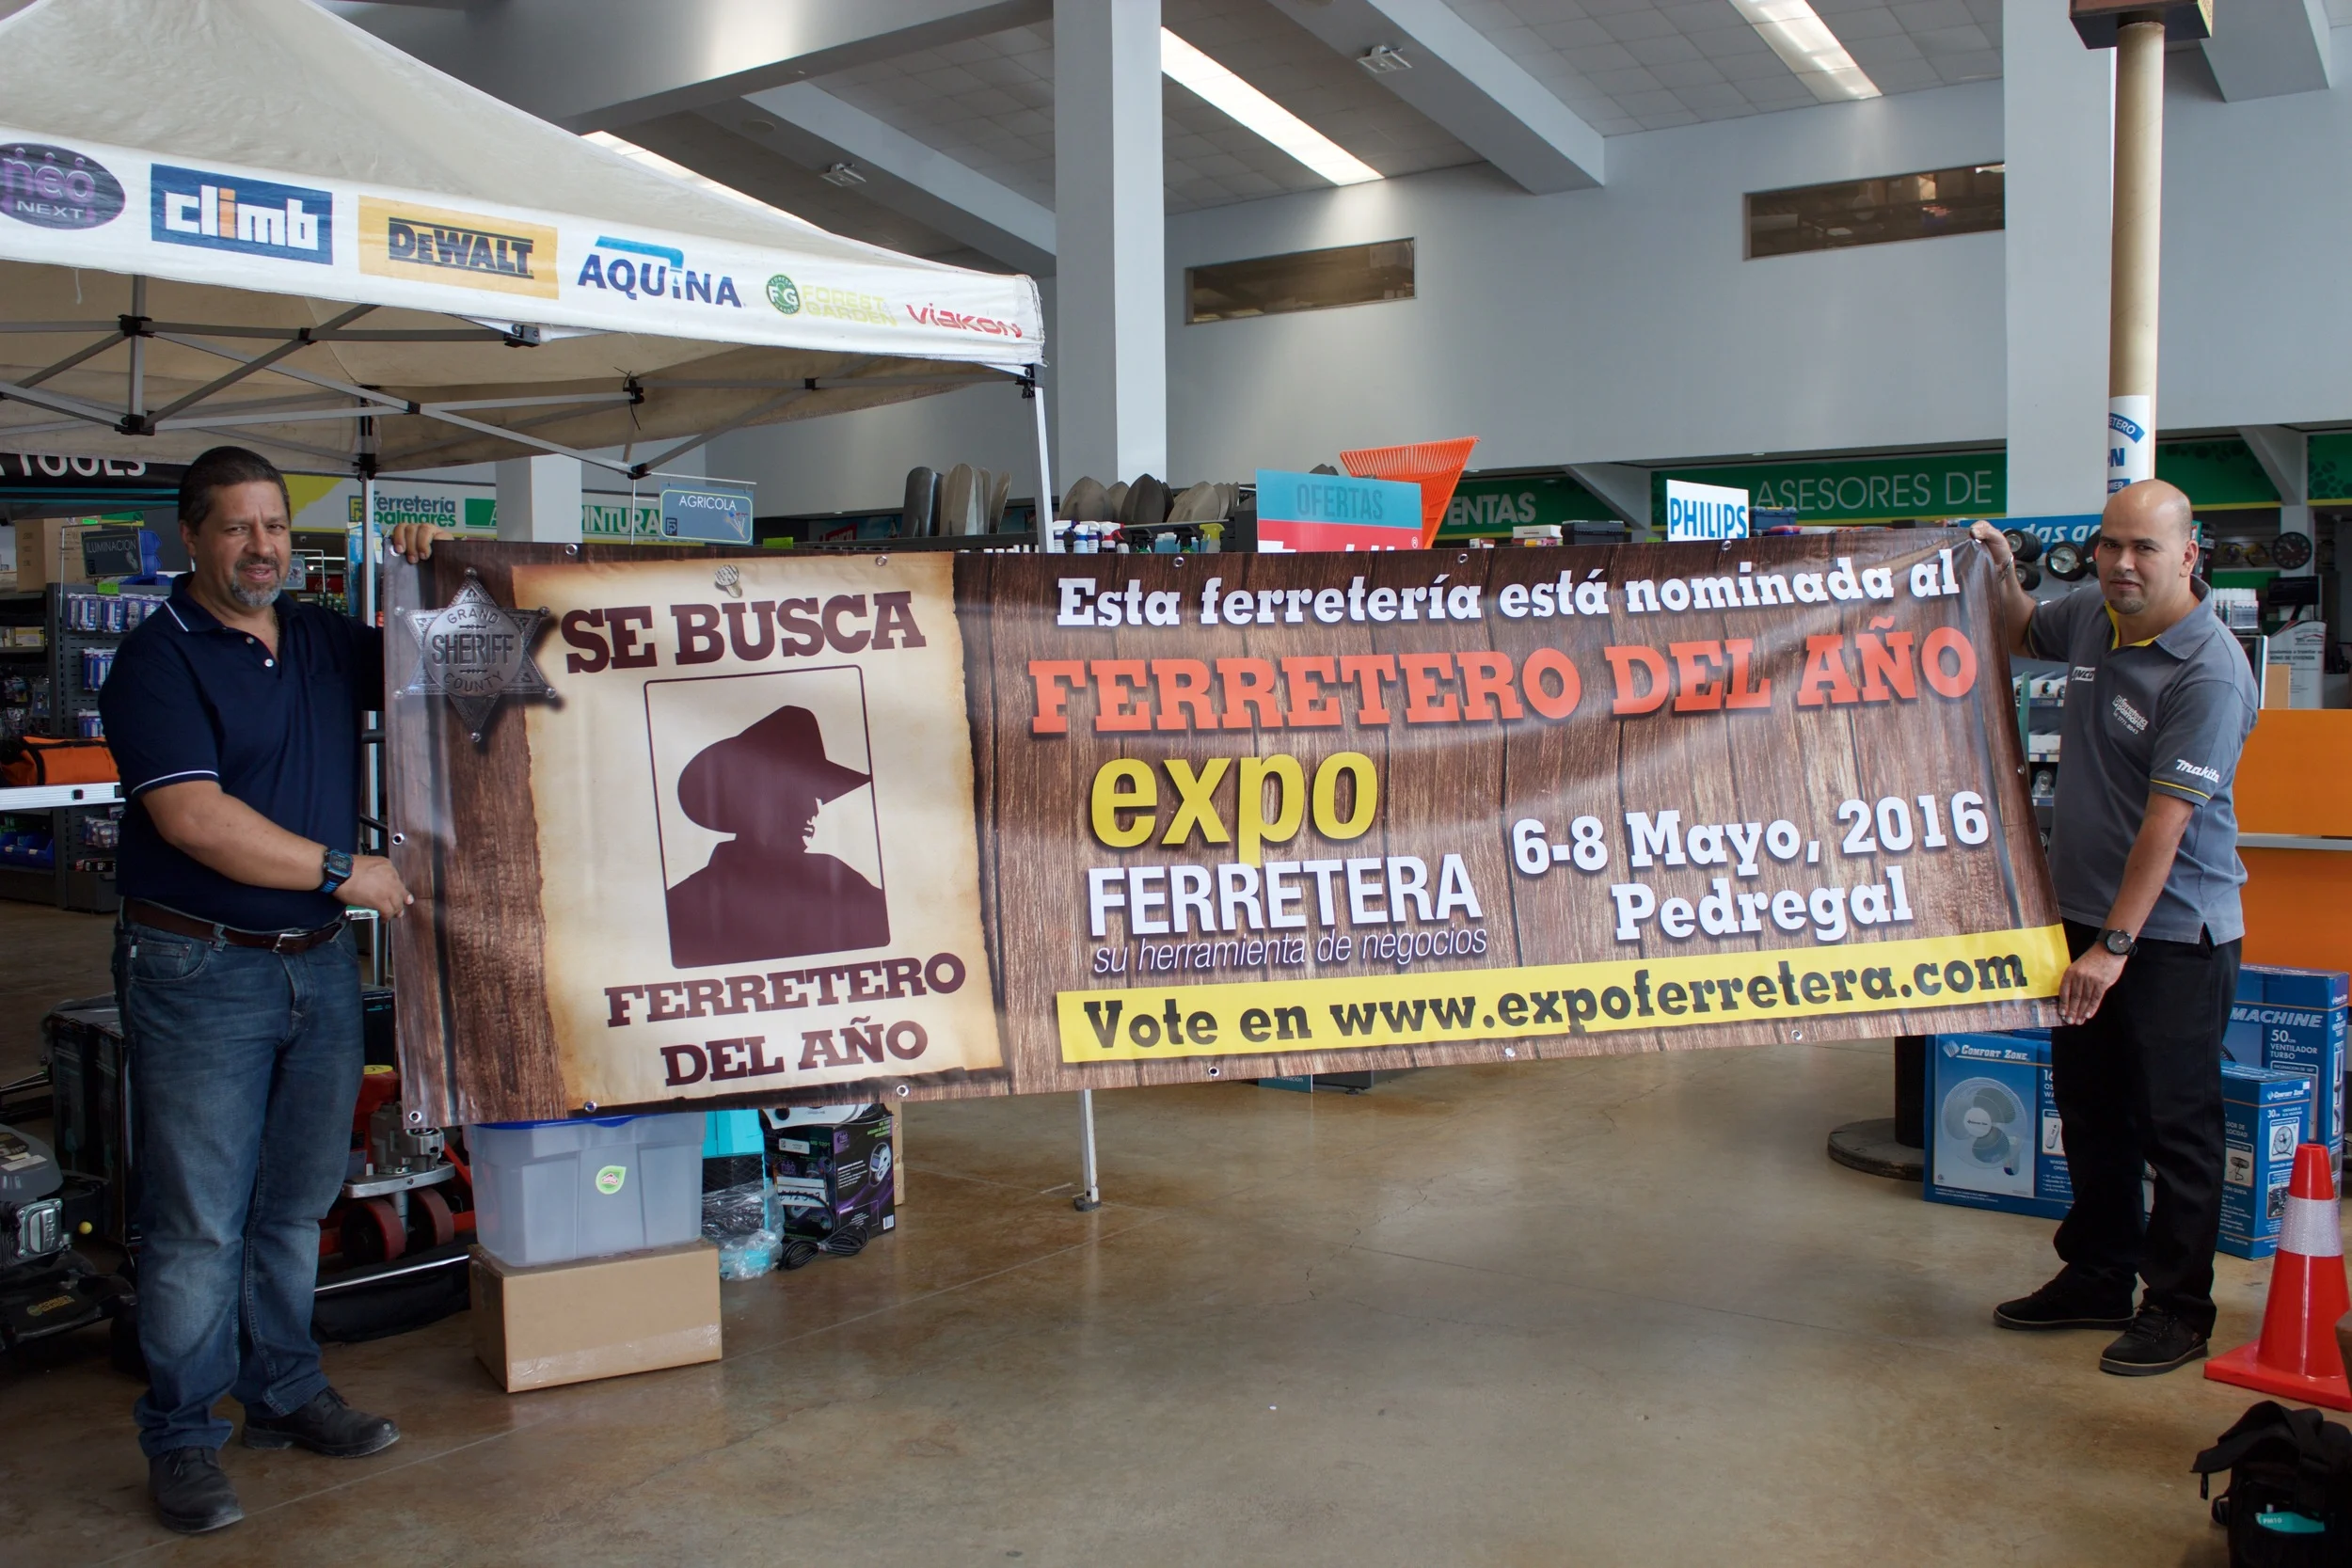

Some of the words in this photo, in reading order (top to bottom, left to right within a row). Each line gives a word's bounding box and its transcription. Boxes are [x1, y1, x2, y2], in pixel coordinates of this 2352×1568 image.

[15, 200, 85, 219] NEXT
[165, 184, 320, 252] climb
[802, 285, 885, 311] FOREST
[805, 302, 898, 326] GARDEN
[679, 495, 737, 511] AGRICOLA
[1296, 483, 1384, 520] OFERTAS
[1755, 472, 1931, 511] ASESORES
[1946, 470, 1992, 505] DE
[1671, 497, 1748, 539] PHILIPS
[86, 539, 136, 554] ILUMINACION
[1057, 578, 1181, 626] Esta
[1201, 573, 1482, 625] ferretería
[1500, 569, 1610, 618] está
[1627, 557, 1895, 613] nominada
[1910, 548, 1961, 597] al
[447, 608, 500, 624] GRAND
[562, 606, 658, 673] SE
[671, 591, 927, 665] BUSCA
[432, 634, 515, 665] SHERIFF
[444, 671, 503, 691] COUNTY
[1029, 647, 1582, 734] FERRETERO
[1604, 639, 1772, 717] DEL
[1797, 615, 1978, 706] AÑO
[2177, 759, 2218, 783] makita
[1090, 752, 1379, 867] expo
[1512, 816, 1609, 875] 6-8
[1626, 810, 1820, 877] Mayo,
[1838, 790, 1990, 855] 2016
[1089, 853, 1485, 937] FERRETERA
[1612, 866, 1913, 942] Pedregal
[1093, 945, 1128, 974] su
[1138, 933, 1306, 971] herramienta
[1317, 928, 1351, 962] de
[1361, 923, 1487, 966] negocios
[605, 952, 965, 1027] FERRETERO
[1085, 999, 1218, 1049] Vote
[1239, 1006, 1311, 1043] en
[1329, 954, 2027, 1035] www.expoferretera.com
[2231, 1007, 2323, 1027] MACHINE
[660, 1036, 785, 1086] DEL
[798, 1016, 928, 1070] AÑO
[1961, 1044, 2002, 1058] COMFORT
[2004, 1049, 2028, 1060] ZONE
[2270, 1043, 2317, 1053] VENTILADOR
[2270, 1051, 2296, 1059] TURBO
